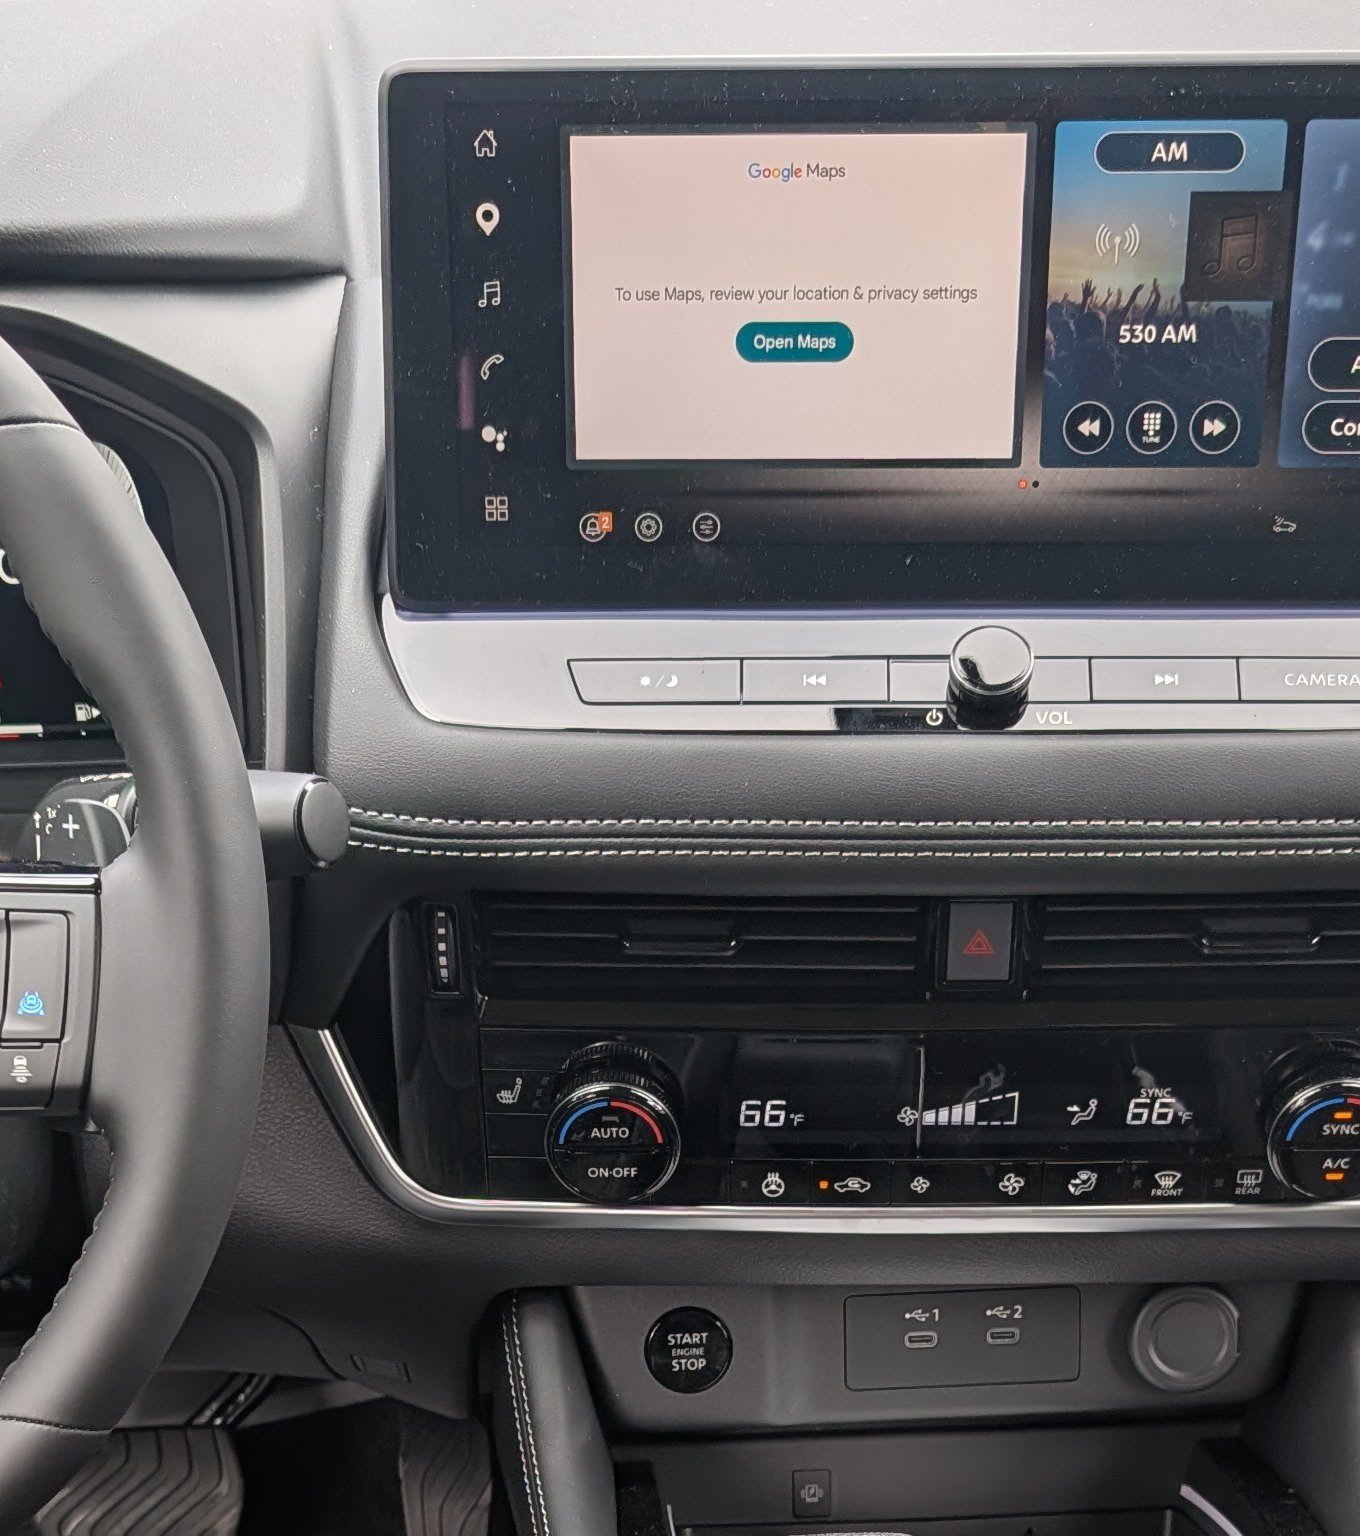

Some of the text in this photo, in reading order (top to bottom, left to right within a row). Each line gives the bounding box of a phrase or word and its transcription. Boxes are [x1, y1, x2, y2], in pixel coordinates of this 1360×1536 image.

[1150, 142, 1189, 163] AM
[748, 162, 846, 182] Google Maps
[615, 285, 979, 306] To use Maps, review your location & privacy settings
[1118, 324, 1197, 344] 530 AM
[753, 335, 837, 354] Open Maps
[601, 514, 611, 529] 2
[1035, 709, 1074, 726] VOL
[1139, 1087, 1172, 1099] SYNC
[590, 1126, 629, 1140] AUTO
[1322, 1122, 1360, 1137] SYNC
[1322, 1157, 1351, 1171] A/C
[1150, 1188, 1183, 1198] FRONT
[1234, 1186, 1261, 1195] REAR
[931, 1308, 940, 1322] 1
[1013, 1305, 1023, 1319] 2
[667, 1332, 708, 1346] START
[671, 1347, 705, 1357] ENGINE
[671, 1357, 707, 1372] STOP
